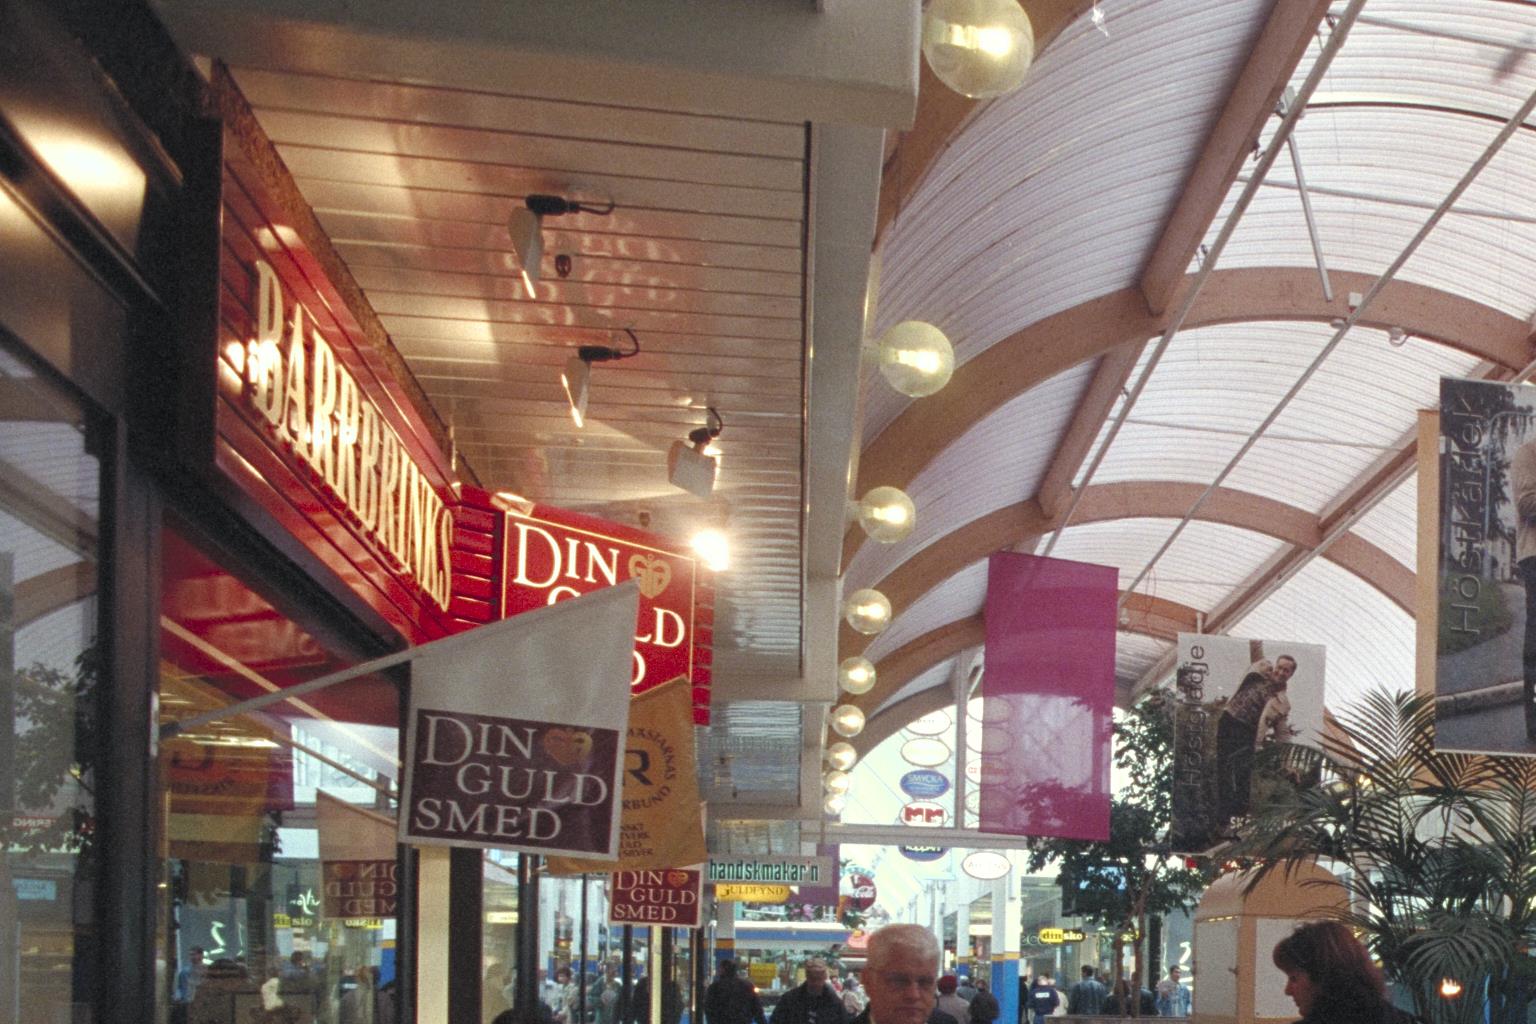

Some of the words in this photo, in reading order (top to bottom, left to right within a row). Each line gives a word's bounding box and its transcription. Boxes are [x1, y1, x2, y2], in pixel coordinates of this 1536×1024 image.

[255, 260, 453, 613] BARRBRINKS
[513, 522, 620, 588] DIN
[421, 715, 537, 766] DIN
[456, 762, 608, 806] GULD
[415, 798, 562, 840] SMED
[617, 871, 663, 890] DIN
[709, 859, 819, 882] handskmakar'n
[614, 903, 677, 921] SMED
[630, 888, 696, 905] GULD
